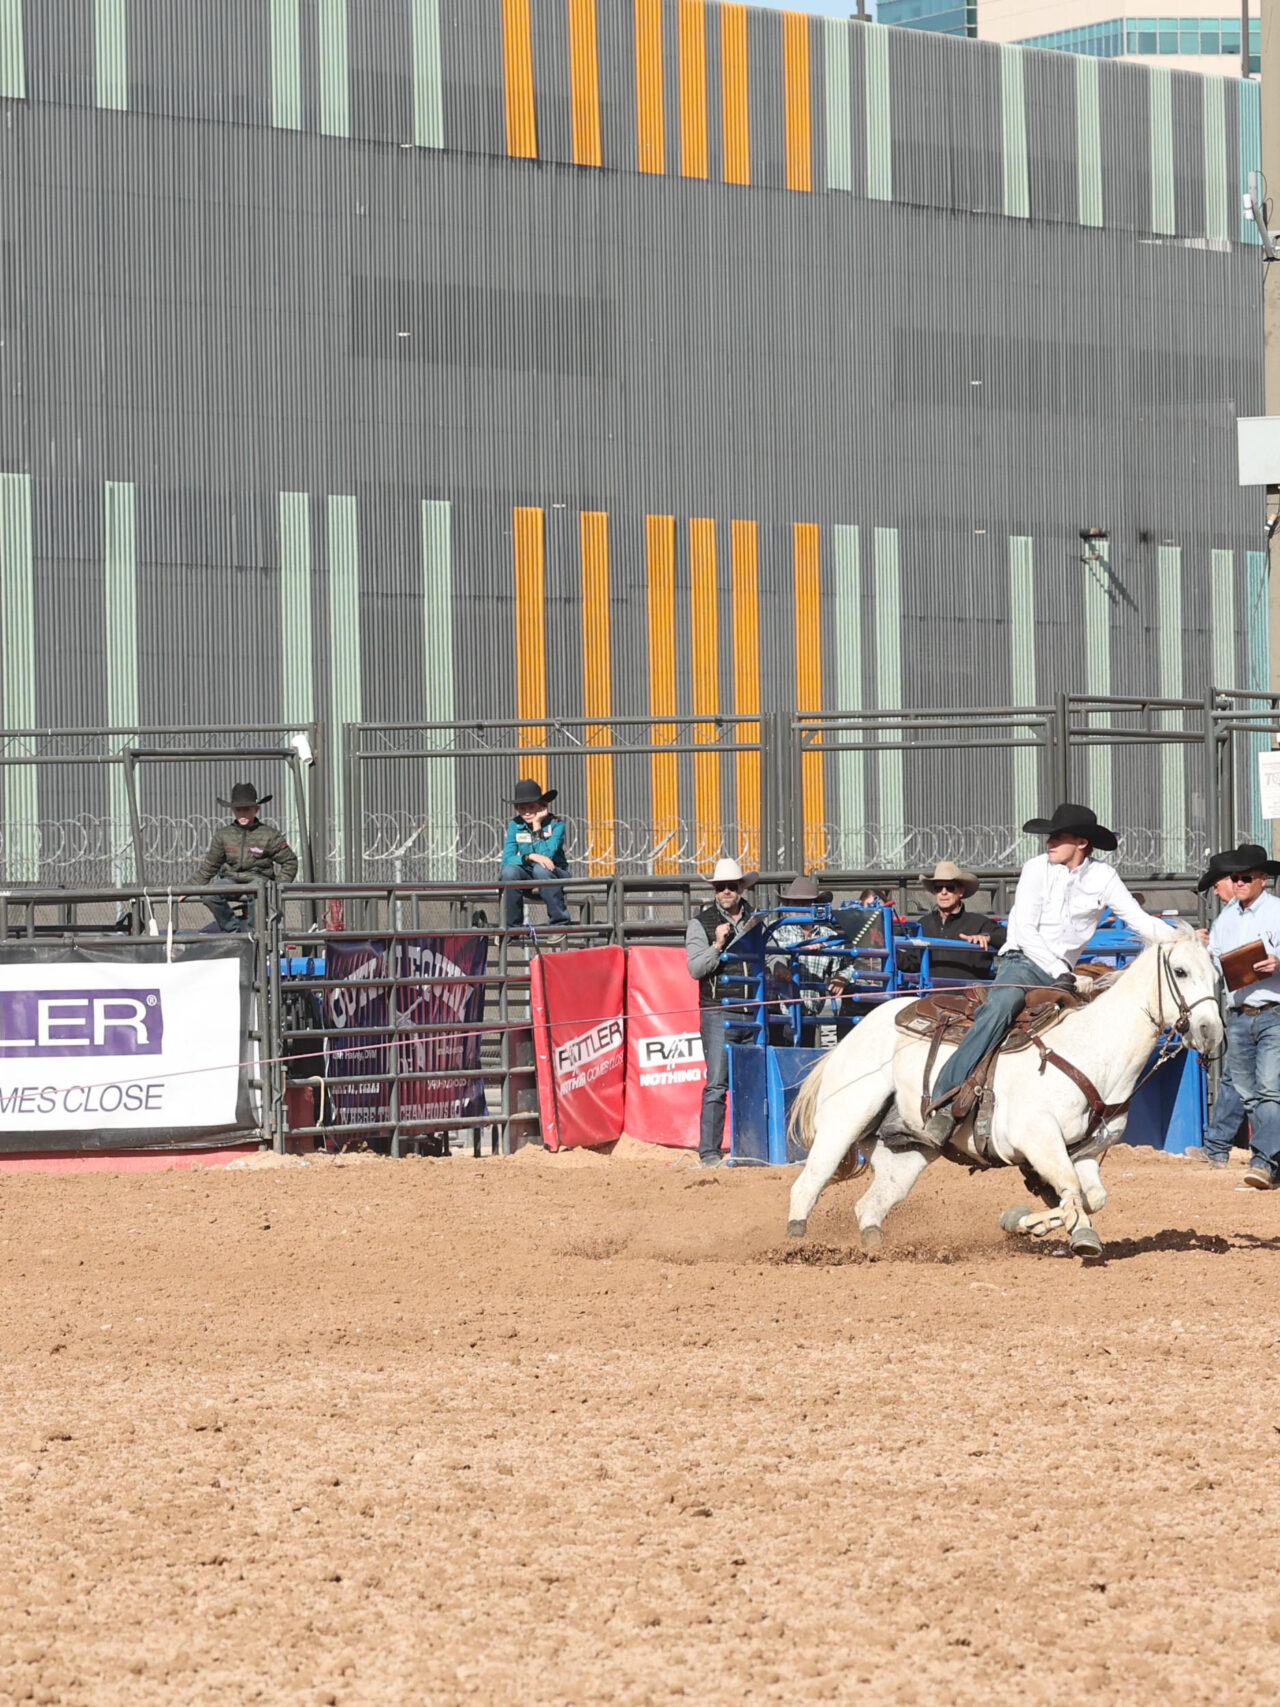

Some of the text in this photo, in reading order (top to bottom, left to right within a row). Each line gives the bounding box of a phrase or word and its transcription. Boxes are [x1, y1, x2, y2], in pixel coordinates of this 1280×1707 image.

[640, 1068, 701, 1087] NOTHING
[63, 1083, 165, 1113] CLOSE
[378, 1105, 391, 1123] TH
